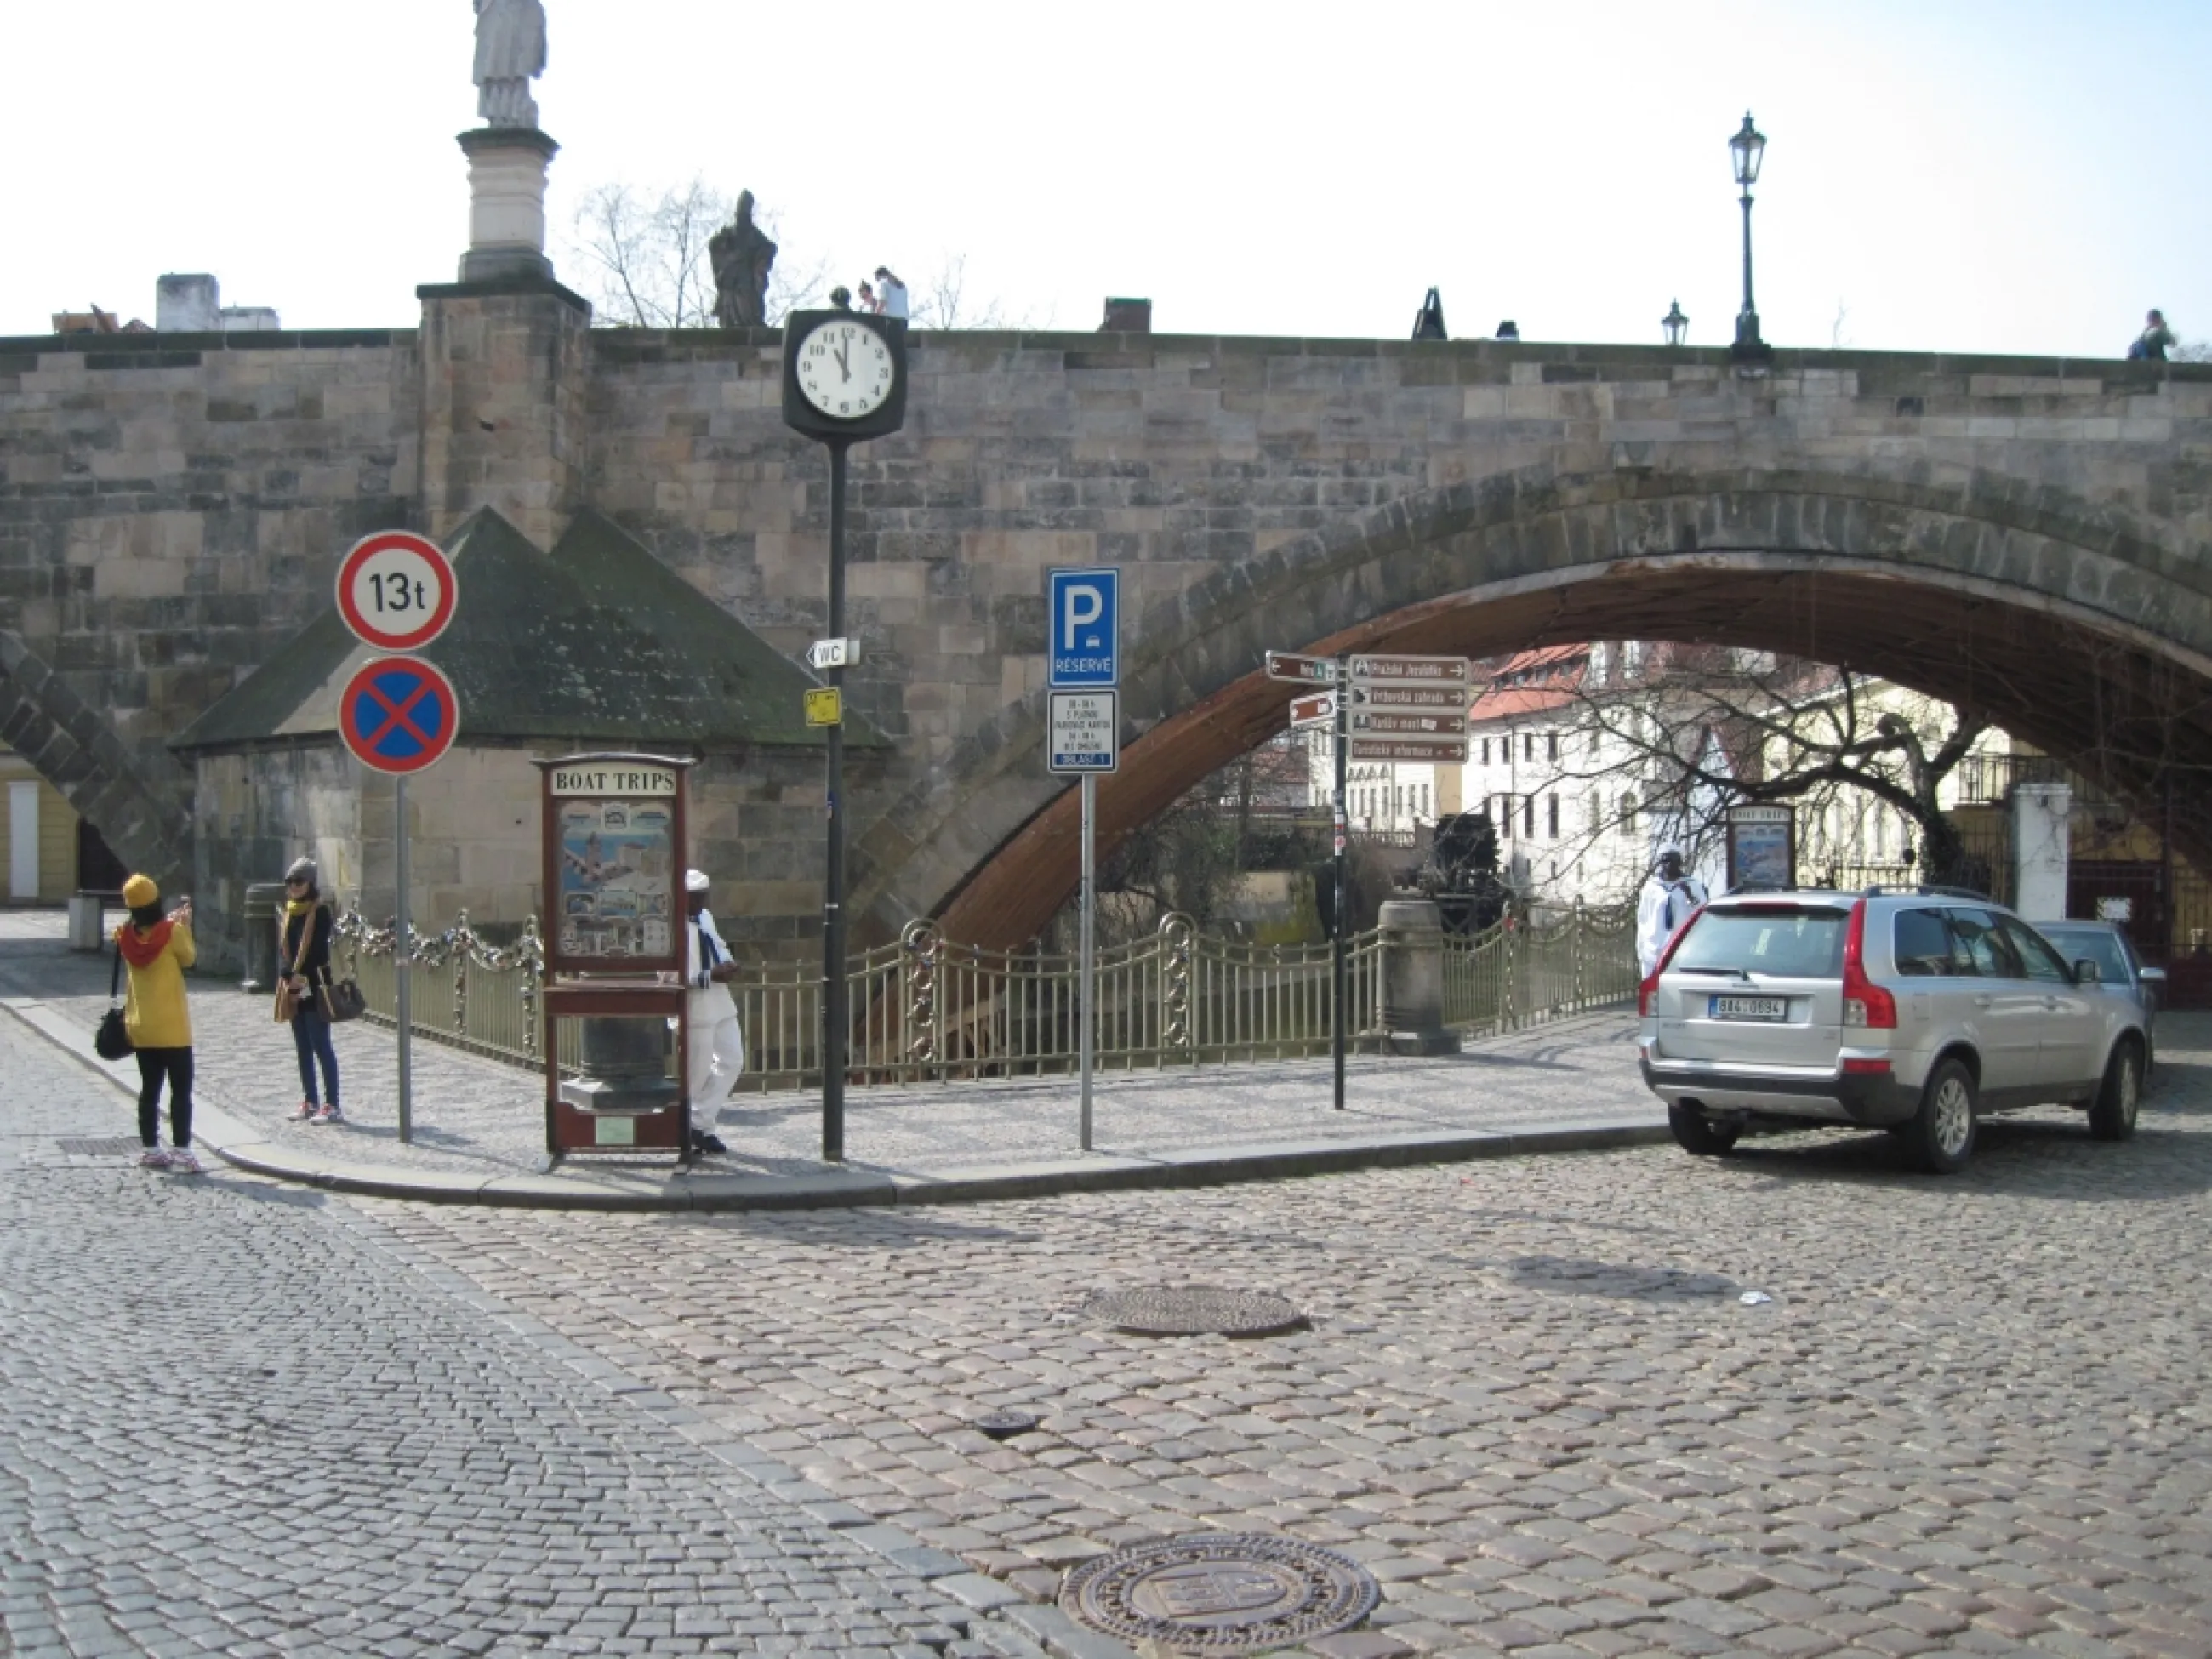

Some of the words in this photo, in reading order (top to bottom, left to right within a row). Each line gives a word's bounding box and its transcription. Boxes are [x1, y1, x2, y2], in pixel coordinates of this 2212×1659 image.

[875, 348, 884, 359] 2
[879, 367, 888, 379] 3
[368, 572, 426, 612] 13t
[1064, 584, 1103, 650] P
[818, 645, 841, 662] WC
[556, 772, 607, 790] BOAT
[613, 772, 675, 790] TRIPS
